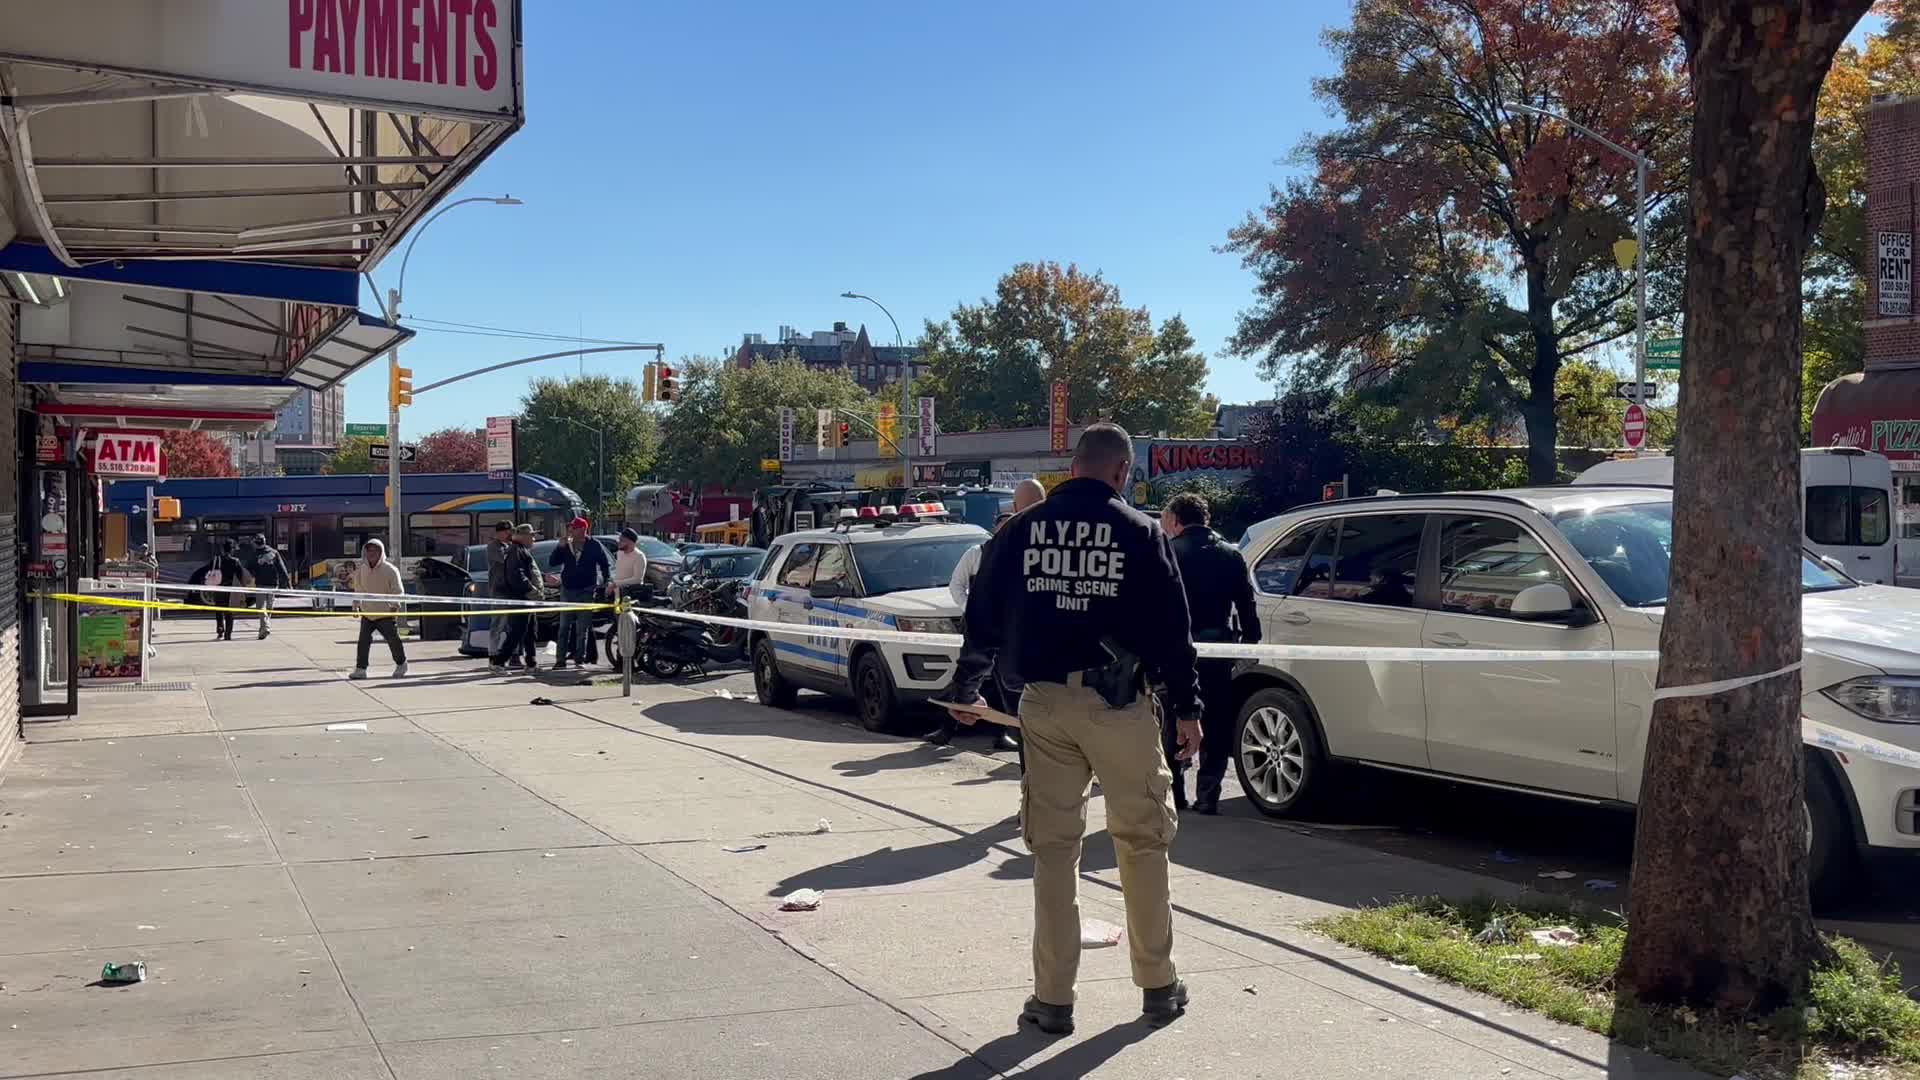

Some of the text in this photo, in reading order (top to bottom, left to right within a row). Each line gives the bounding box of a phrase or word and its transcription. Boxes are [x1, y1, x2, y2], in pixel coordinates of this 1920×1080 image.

[289, 0, 498, 91] PAYMENTS
[1880, 233, 1910, 247] OFFICE
[1886, 247, 1906, 257] FOR
[1880, 257, 1910, 280] RENT
[920, 400, 932, 456] BAKERY
[1831, 425, 1866, 448] Emilio's
[98, 439, 156, 463] ATM
[125, 463, 139, 473] $20
[290, 504, 307, 512] NY
[1030, 520, 1119, 548] N.Y.P.D.
[27, 570, 50, 578] PULL
[1023, 548, 1126, 580] POLICE
[1026, 577, 1120, 597] CRIME SCENE
[1056, 594, 1091, 612] UNIT
